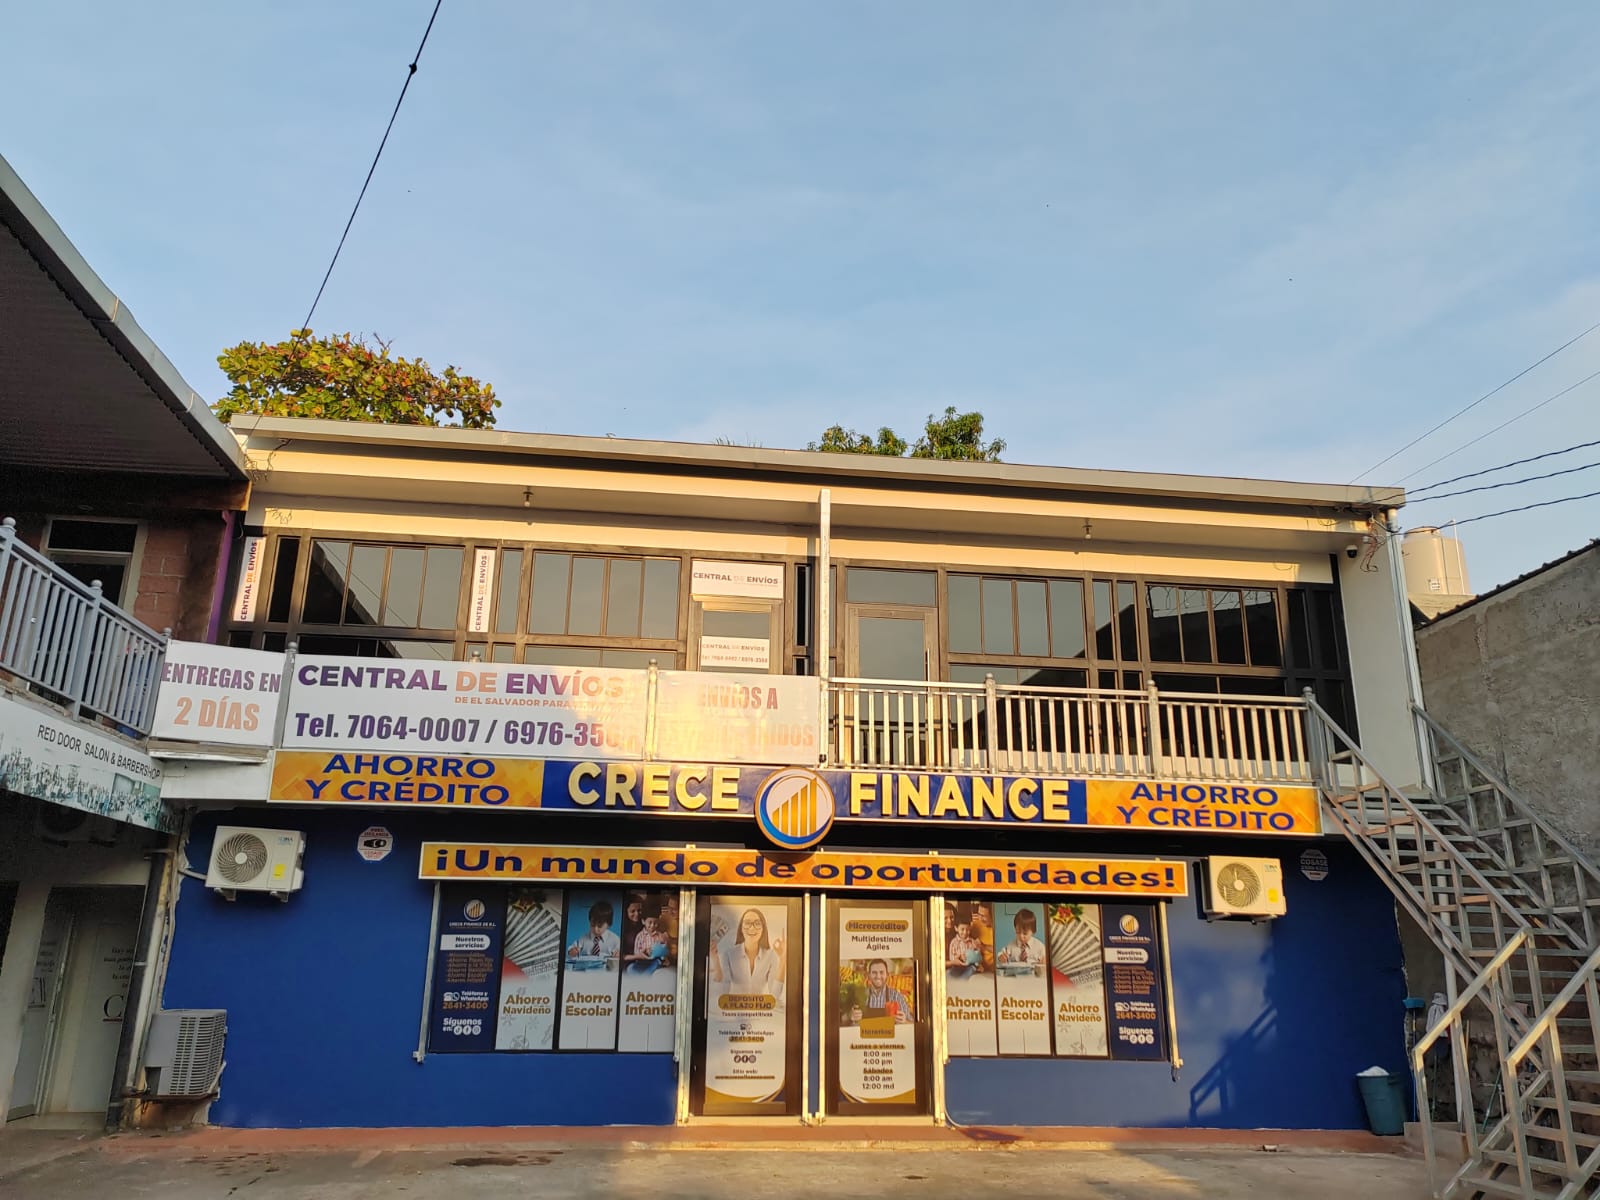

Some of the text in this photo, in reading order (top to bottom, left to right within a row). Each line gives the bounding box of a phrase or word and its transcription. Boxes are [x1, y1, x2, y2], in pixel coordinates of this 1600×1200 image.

[693, 572, 732, 582] CENTRAL
[746, 576, 778, 584] ENVÍOS
[241, 584, 252, 620] CENTRAL
[475, 596, 484, 631] CENTRAL
[161, 662, 282, 693] ENTREGAS EN
[298, 665, 624, 698] CENTRAL DE ENVÍOS
[454, 696, 468, 704] DE
[485, 698, 540, 708] SALVADOR
[766, 688, 778, 710] A
[174, 696, 260, 732] 2 DÍAS
[296, 712, 339, 738] Tel.
[347, 714, 480, 743] 7064-0007
[484, 720, 498, 744] /
[37, 724, 160, 780] RED DOOR SALON & BARBERSHOP
[322, 754, 496, 779] AHORRO
[306, 776, 510, 806] Y CRÉDITO
[568, 762, 741, 810] CRECE
[850, 772, 1071, 822] FINANCE
[1130, 783, 1279, 806] AHORRO
[1116, 804, 1295, 832] Y CRÉDITO
[541, 853, 720, 878] mundo
[735, 856, 797, 878] de
[811, 862, 1174, 888] oportunidades!
[848, 922, 906, 930] Microcréditos
[506, 994, 550, 1005] Ahorro
[566, 992, 612, 1003] Ahorro
[626, 992, 674, 1002] Ahorro
[946, 996, 991, 1008] Ahorro
[1001, 997, 1043, 1008] Ahorro
[503, 1006, 552, 1014] Navideño
[566, 1005, 612, 1016] Escolar
[625, 1004, 674, 1016] Infantil
[1060, 1002, 1100, 1013] Ahorro
[946, 1008, 992, 1020] Infantil
[1001, 1010, 1046, 1021] Escolar
[1058, 1014, 1102, 1022] Navideño
[442, 1017, 482, 1028] Síguenos
